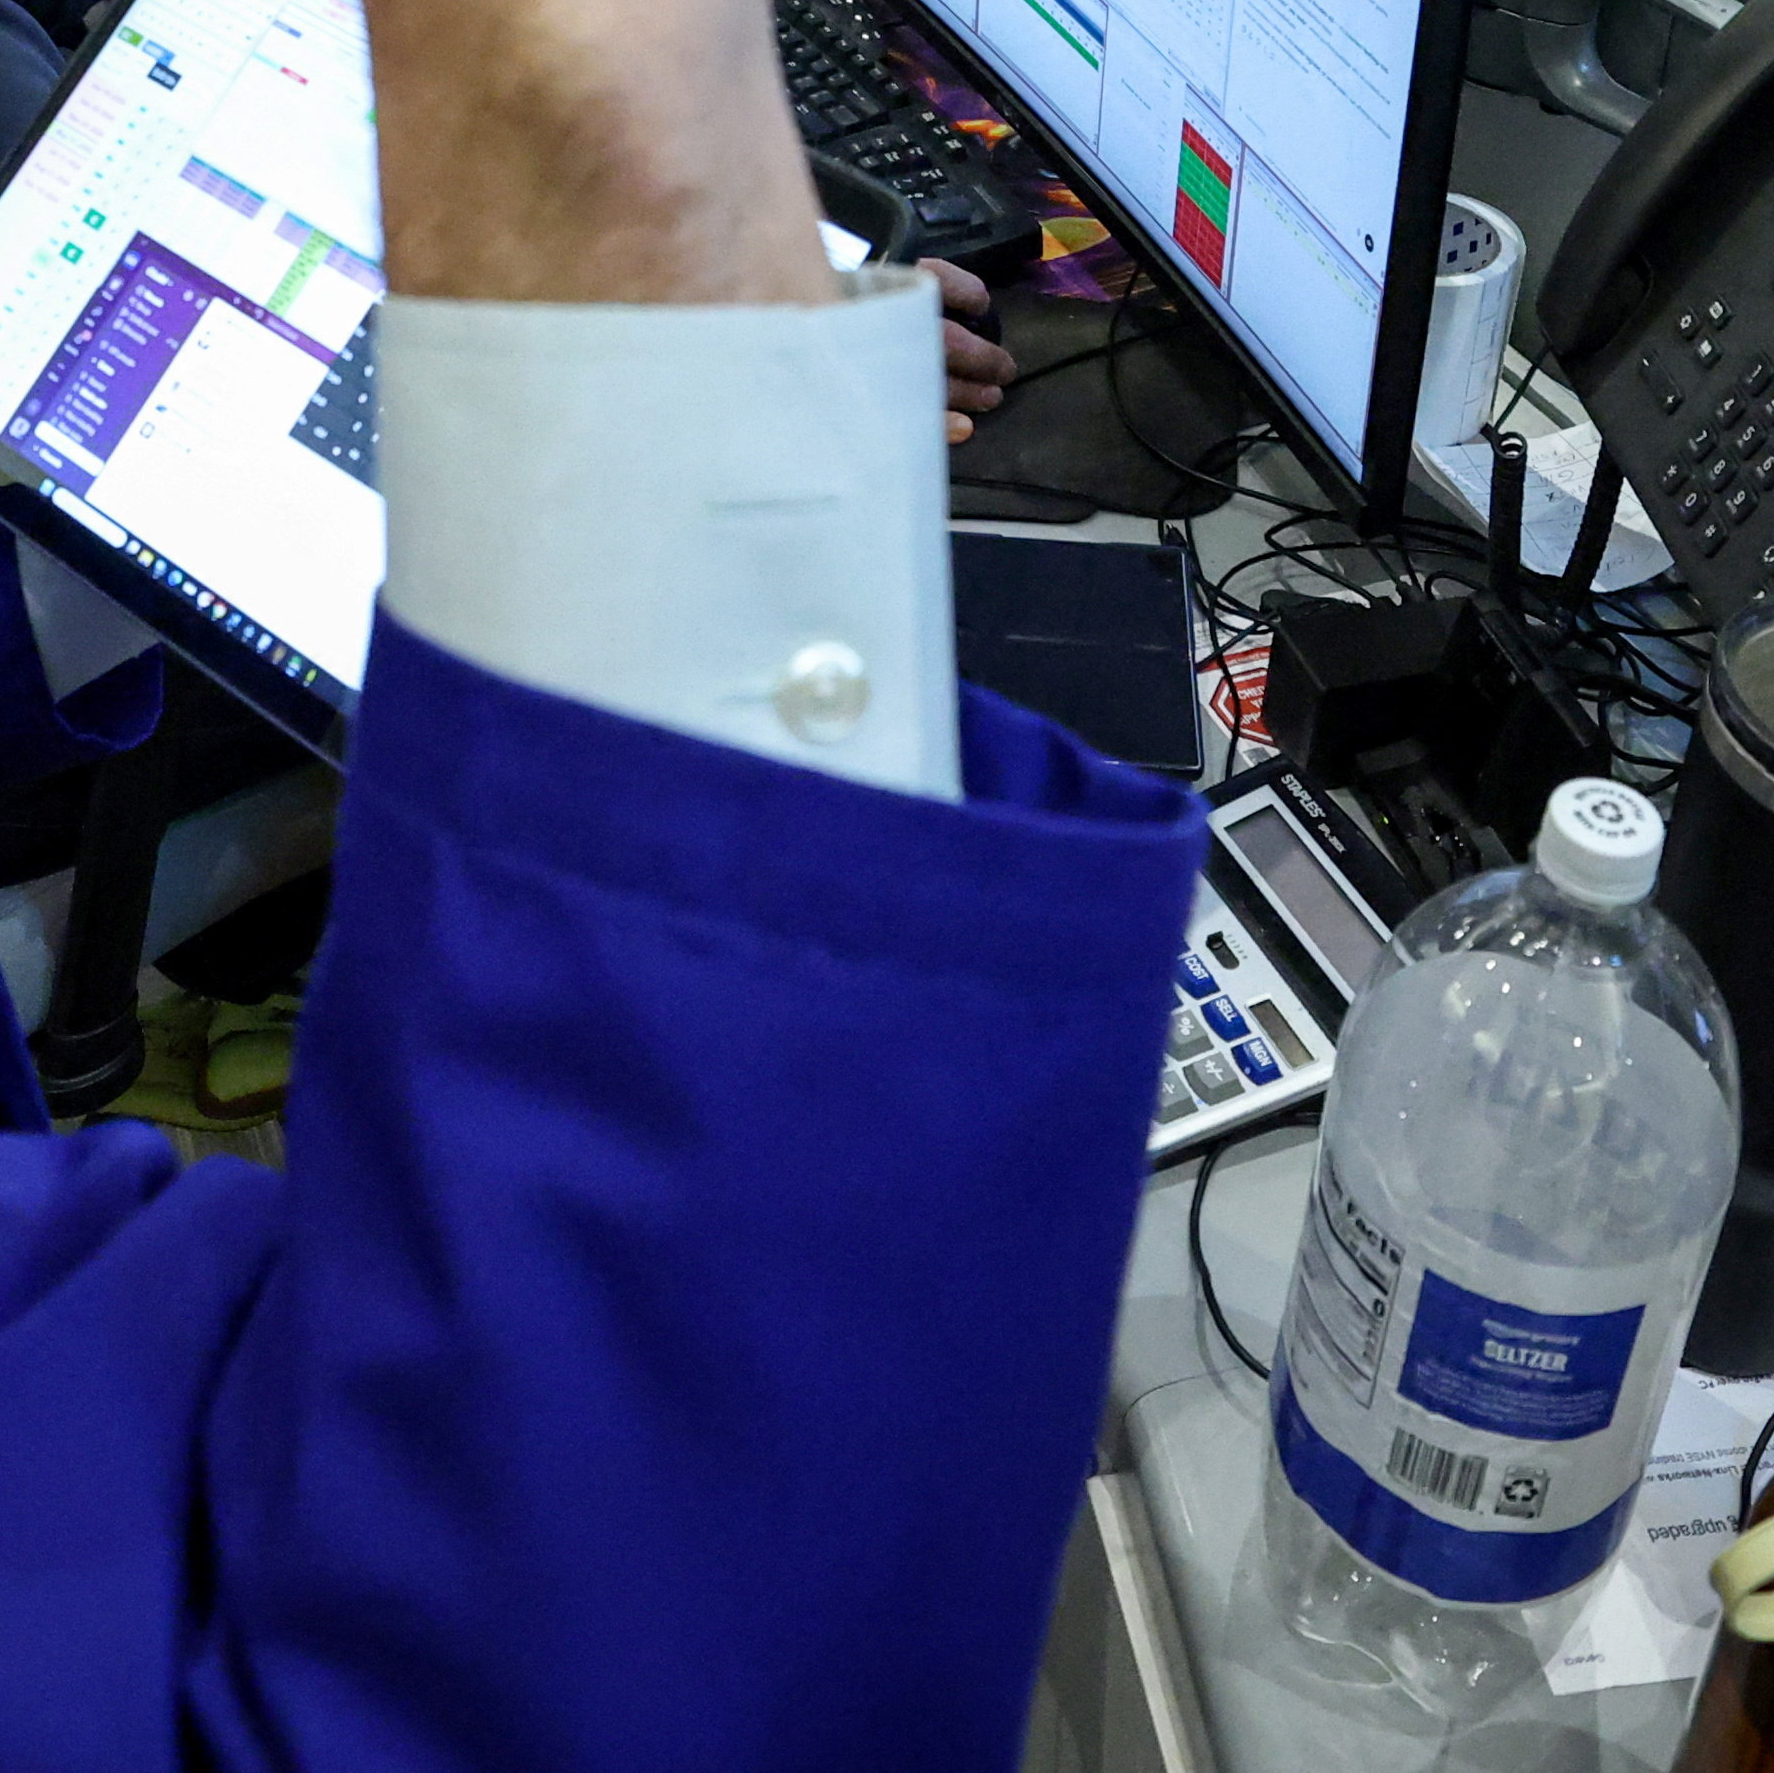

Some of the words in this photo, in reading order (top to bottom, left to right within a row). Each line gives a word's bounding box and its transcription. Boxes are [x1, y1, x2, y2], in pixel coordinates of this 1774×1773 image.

[1751, 363, 1762, 378] 1
[1723, 397, 1735, 411] 4
[1695, 429, 1708, 443] 7
[1742, 425, 1756, 442] 5
[1713, 458, 1726, 475] 8
[1685, 492, 1697, 507] 0
[1733, 489, 1746, 506] 9
[1184, 955, 1210, 981] COST
[1215, 998, 1238, 1023] SELL
[1248, 1040, 1273, 1068] MGN
[1483, 1338, 1569, 1373] SELTZER
[1646, 1519, 1728, 1543] upgraded
